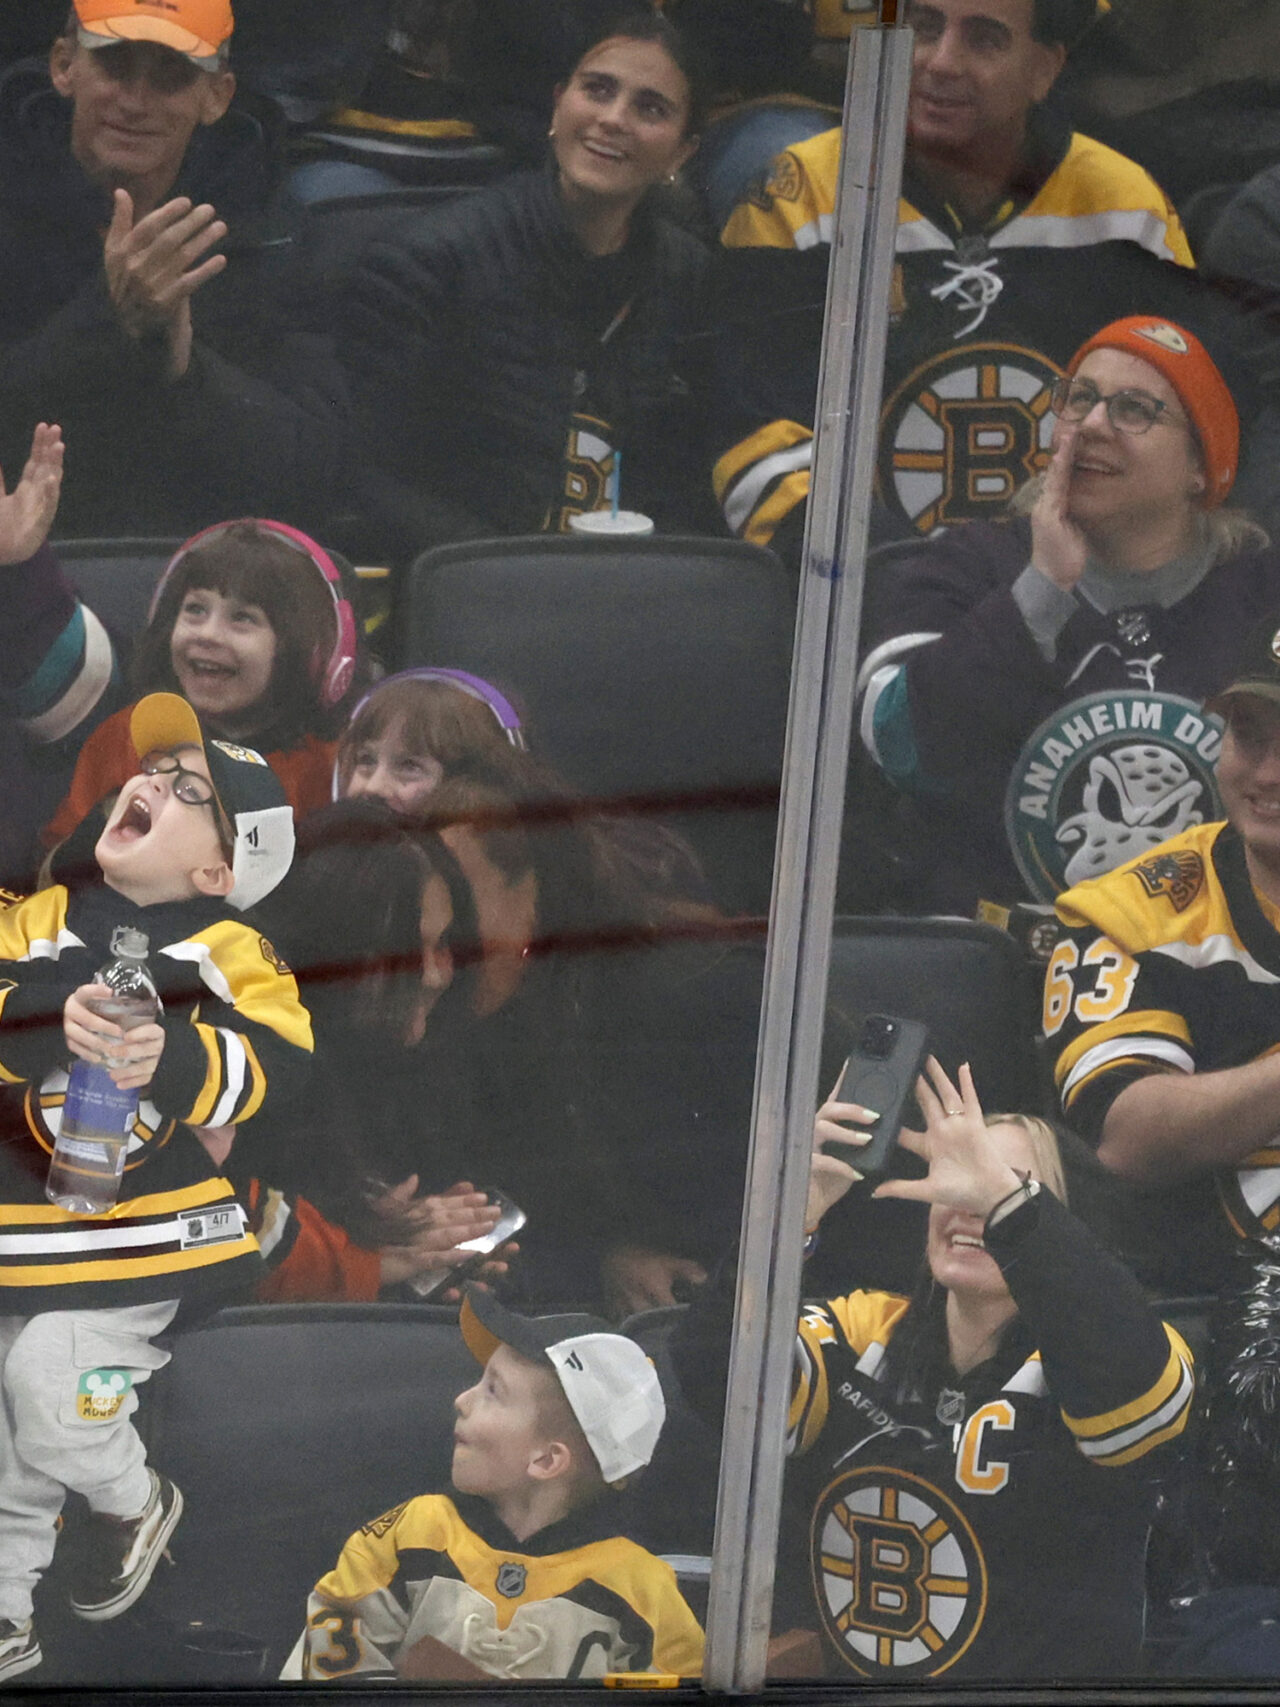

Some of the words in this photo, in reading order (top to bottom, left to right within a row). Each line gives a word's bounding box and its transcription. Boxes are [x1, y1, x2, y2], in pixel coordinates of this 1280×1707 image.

[938, 400, 1038, 523] B
[1020, 701, 1163, 820] ANAHEIM
[1042, 937, 1141, 1039] 63
[955, 1399, 1017, 1496] C
[850, 1514, 932, 1638] B
